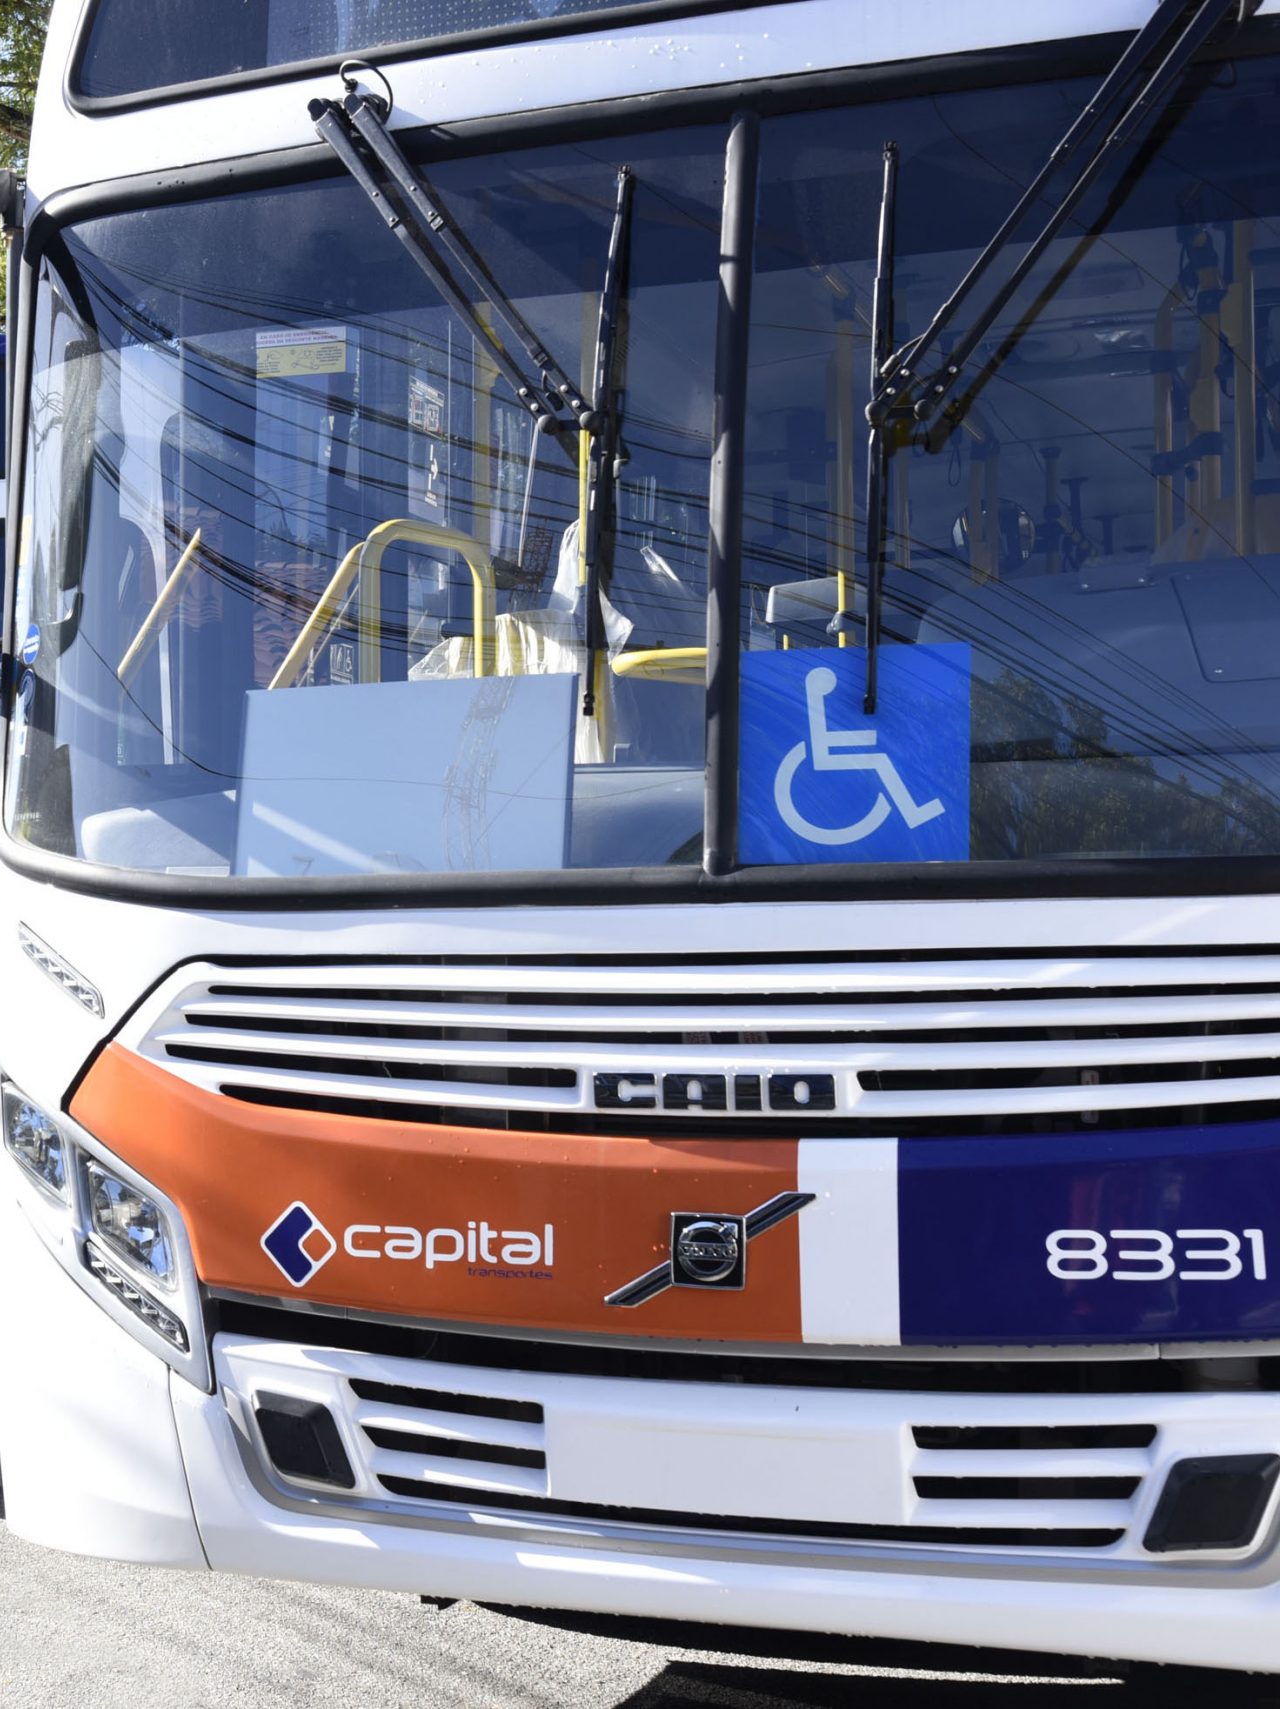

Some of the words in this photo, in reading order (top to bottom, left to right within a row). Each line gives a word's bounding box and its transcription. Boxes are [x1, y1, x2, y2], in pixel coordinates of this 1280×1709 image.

[592, 1072, 836, 1111] CAIO
[343, 1221, 554, 1270] capital
[1045, 1229, 1267, 1281] 8331
[468, 1266, 553, 1280] transportes
